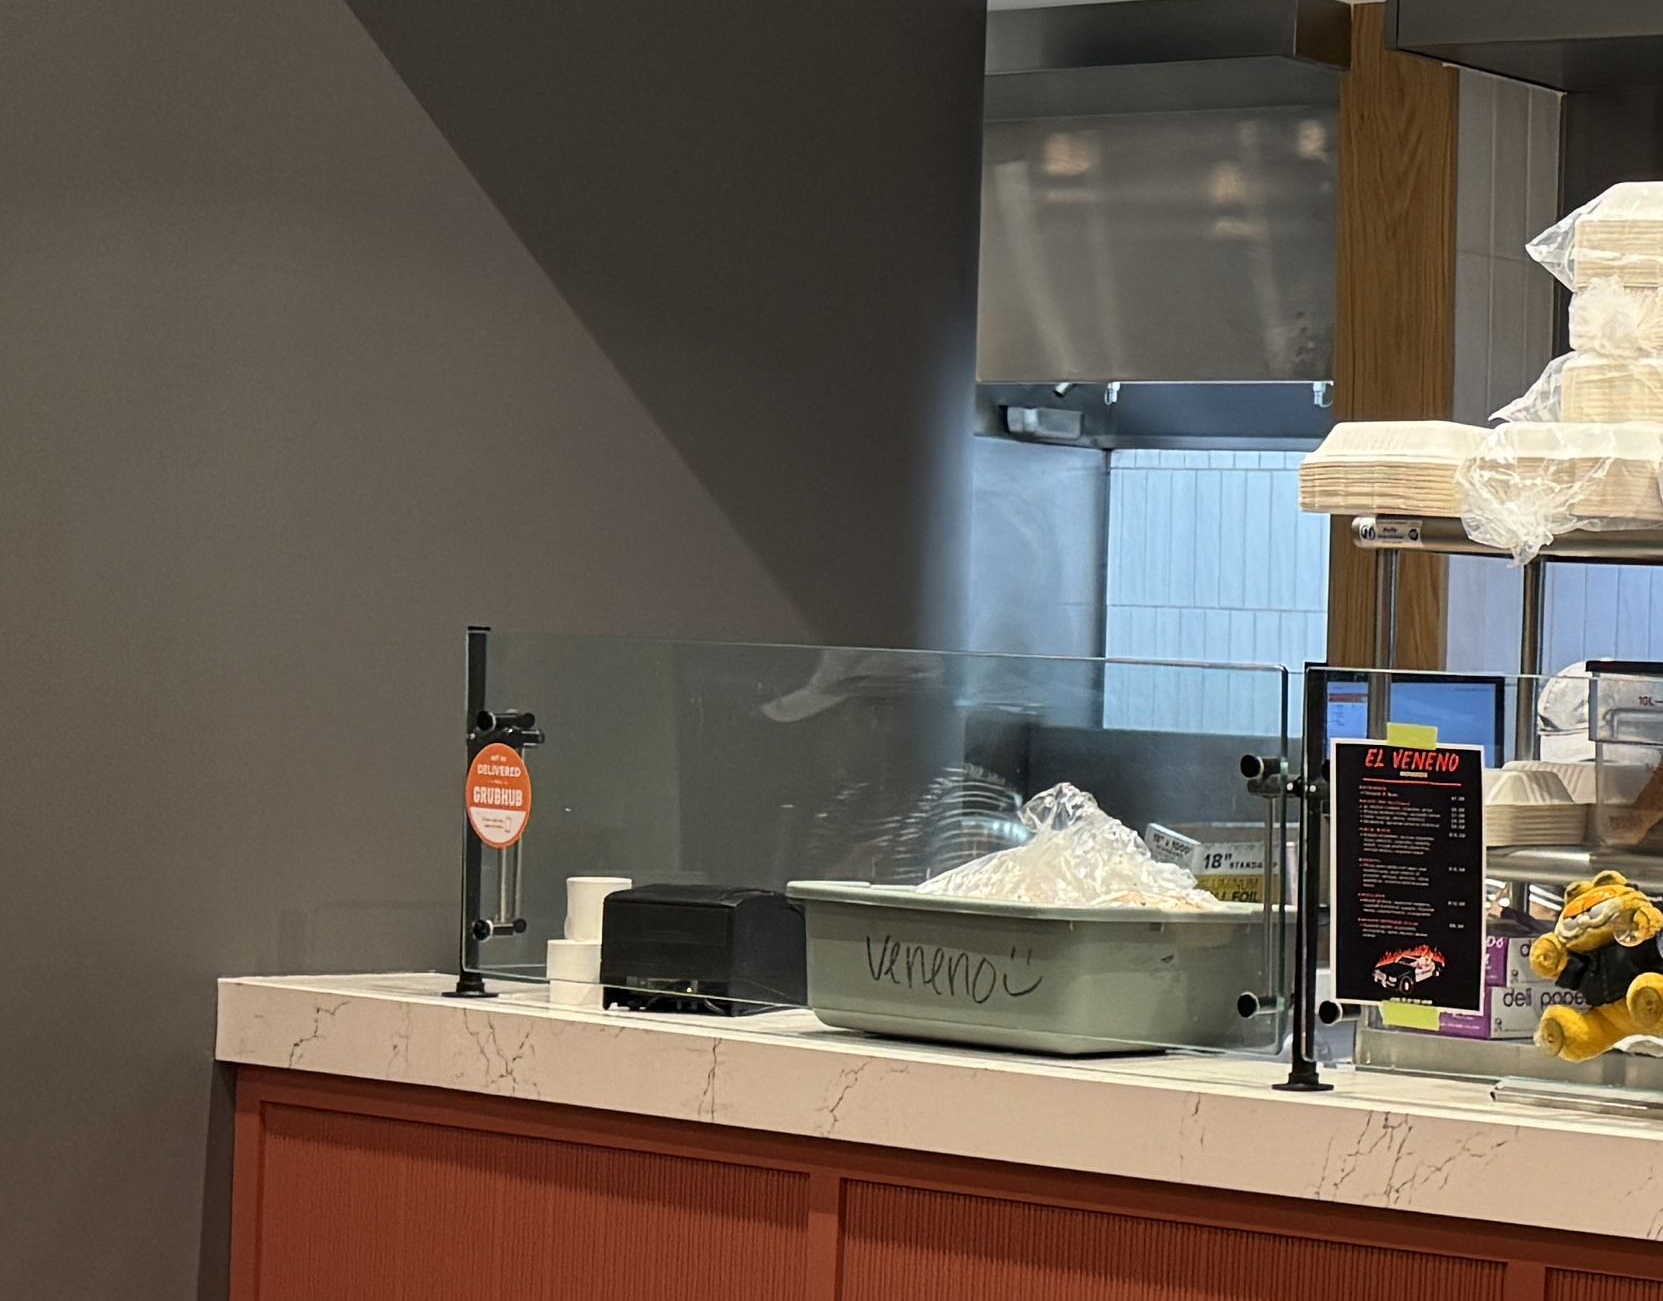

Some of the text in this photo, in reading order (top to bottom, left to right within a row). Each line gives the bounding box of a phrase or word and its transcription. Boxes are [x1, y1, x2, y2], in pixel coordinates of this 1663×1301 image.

[1365, 748, 1460, 772] EL VENENO
[477, 764, 521, 777] DELIVERED
[473, 786, 523, 806] GRUBHUB
[1541, 991, 1585, 1011] pape
